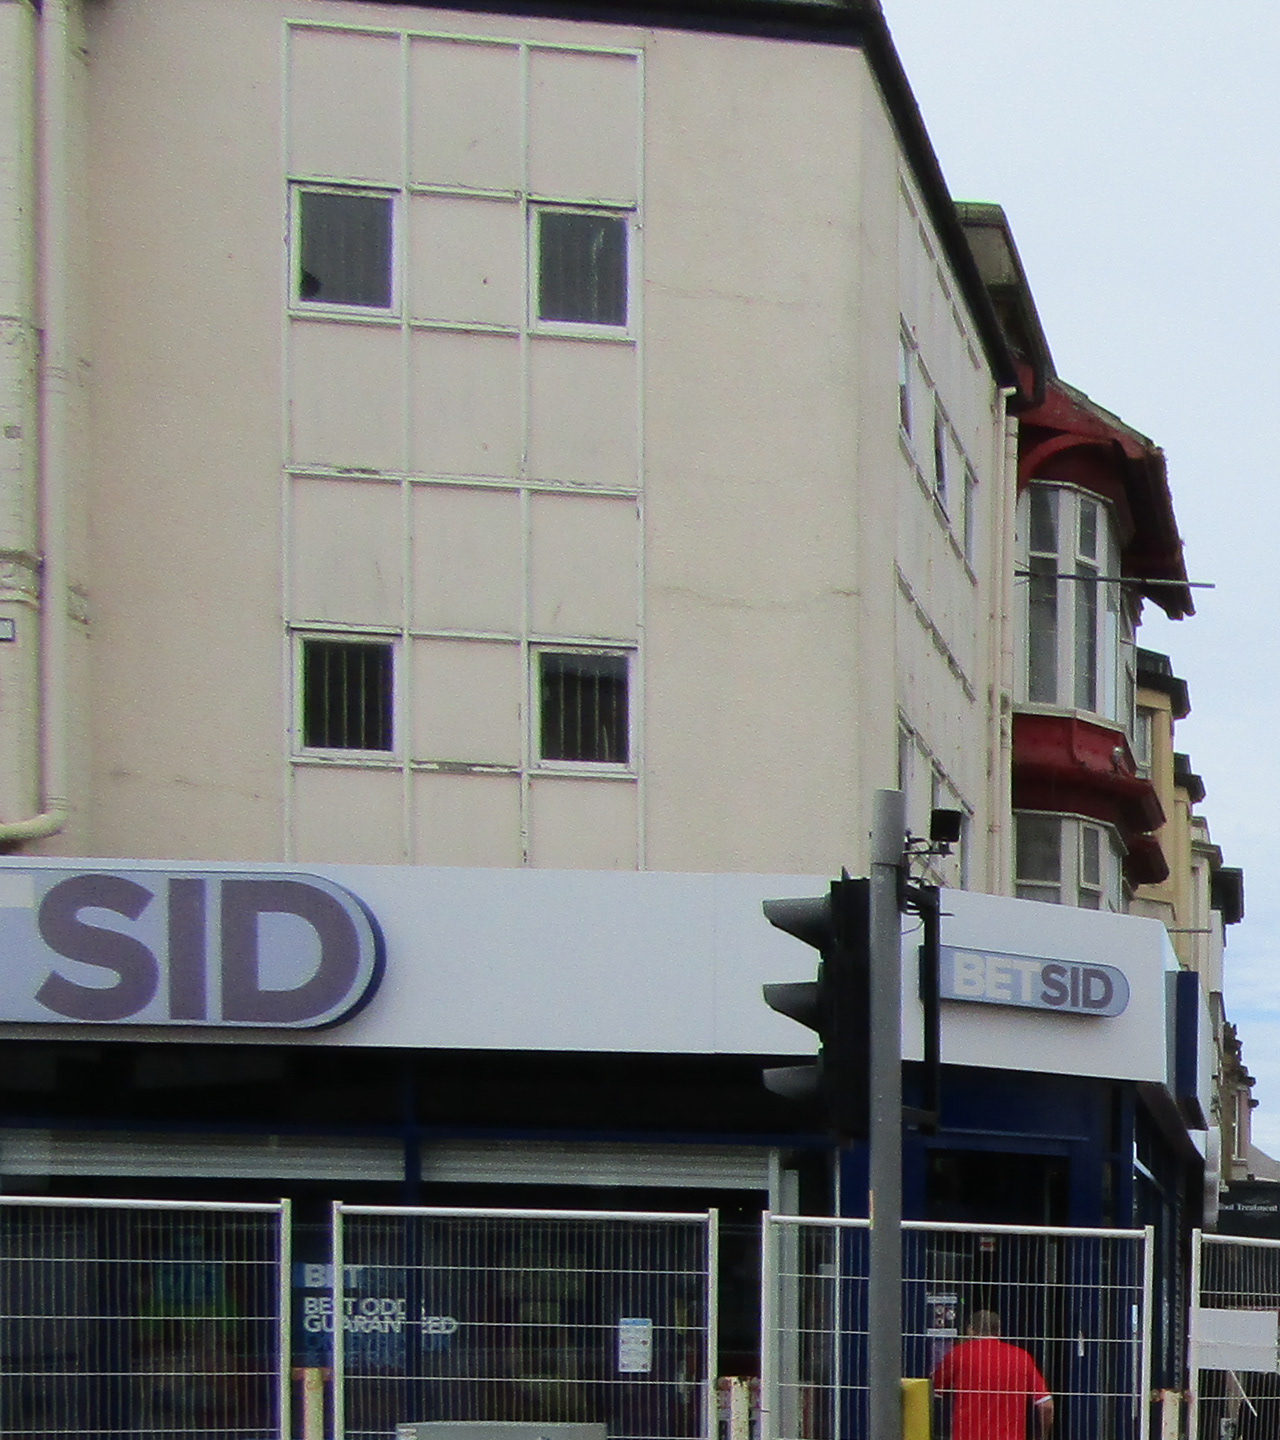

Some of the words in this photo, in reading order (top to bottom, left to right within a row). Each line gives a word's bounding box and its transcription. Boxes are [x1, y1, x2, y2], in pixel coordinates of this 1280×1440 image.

[954, 952, 1113, 1009] BETSID
[1237, 1203, 1278, 1213] Treatment
[304, 1297, 357, 1315] BET
[304, 1315, 458, 1335] GUARANED
